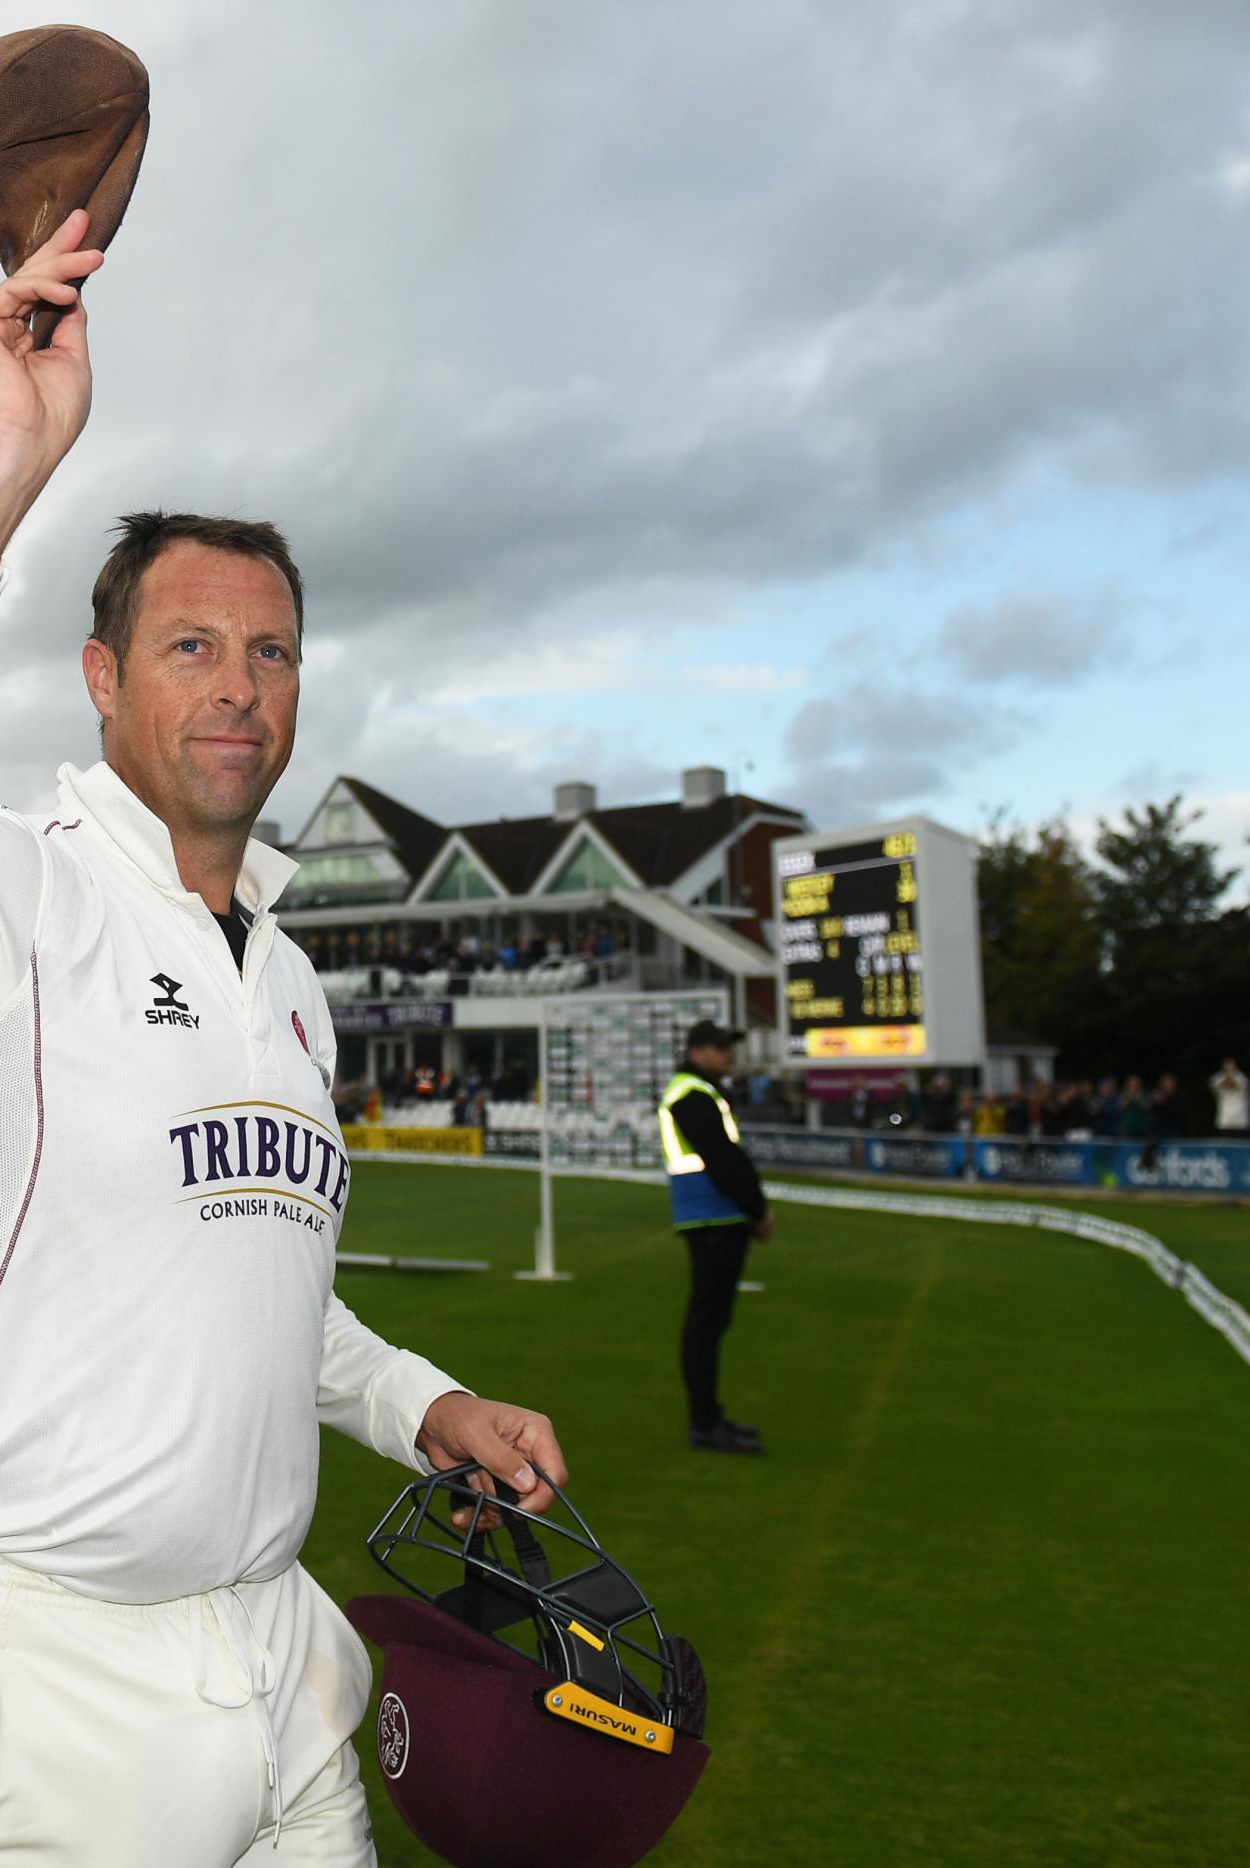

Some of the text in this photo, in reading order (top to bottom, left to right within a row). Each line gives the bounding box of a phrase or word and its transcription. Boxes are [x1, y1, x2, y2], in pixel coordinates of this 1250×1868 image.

[145, 1009, 200, 1030] SHREY
[169, 1116, 350, 1213] TRIBUTE
[200, 1199, 326, 1236] CORNISH PALE ALE
[570, 1703, 637, 1736] MASURI
